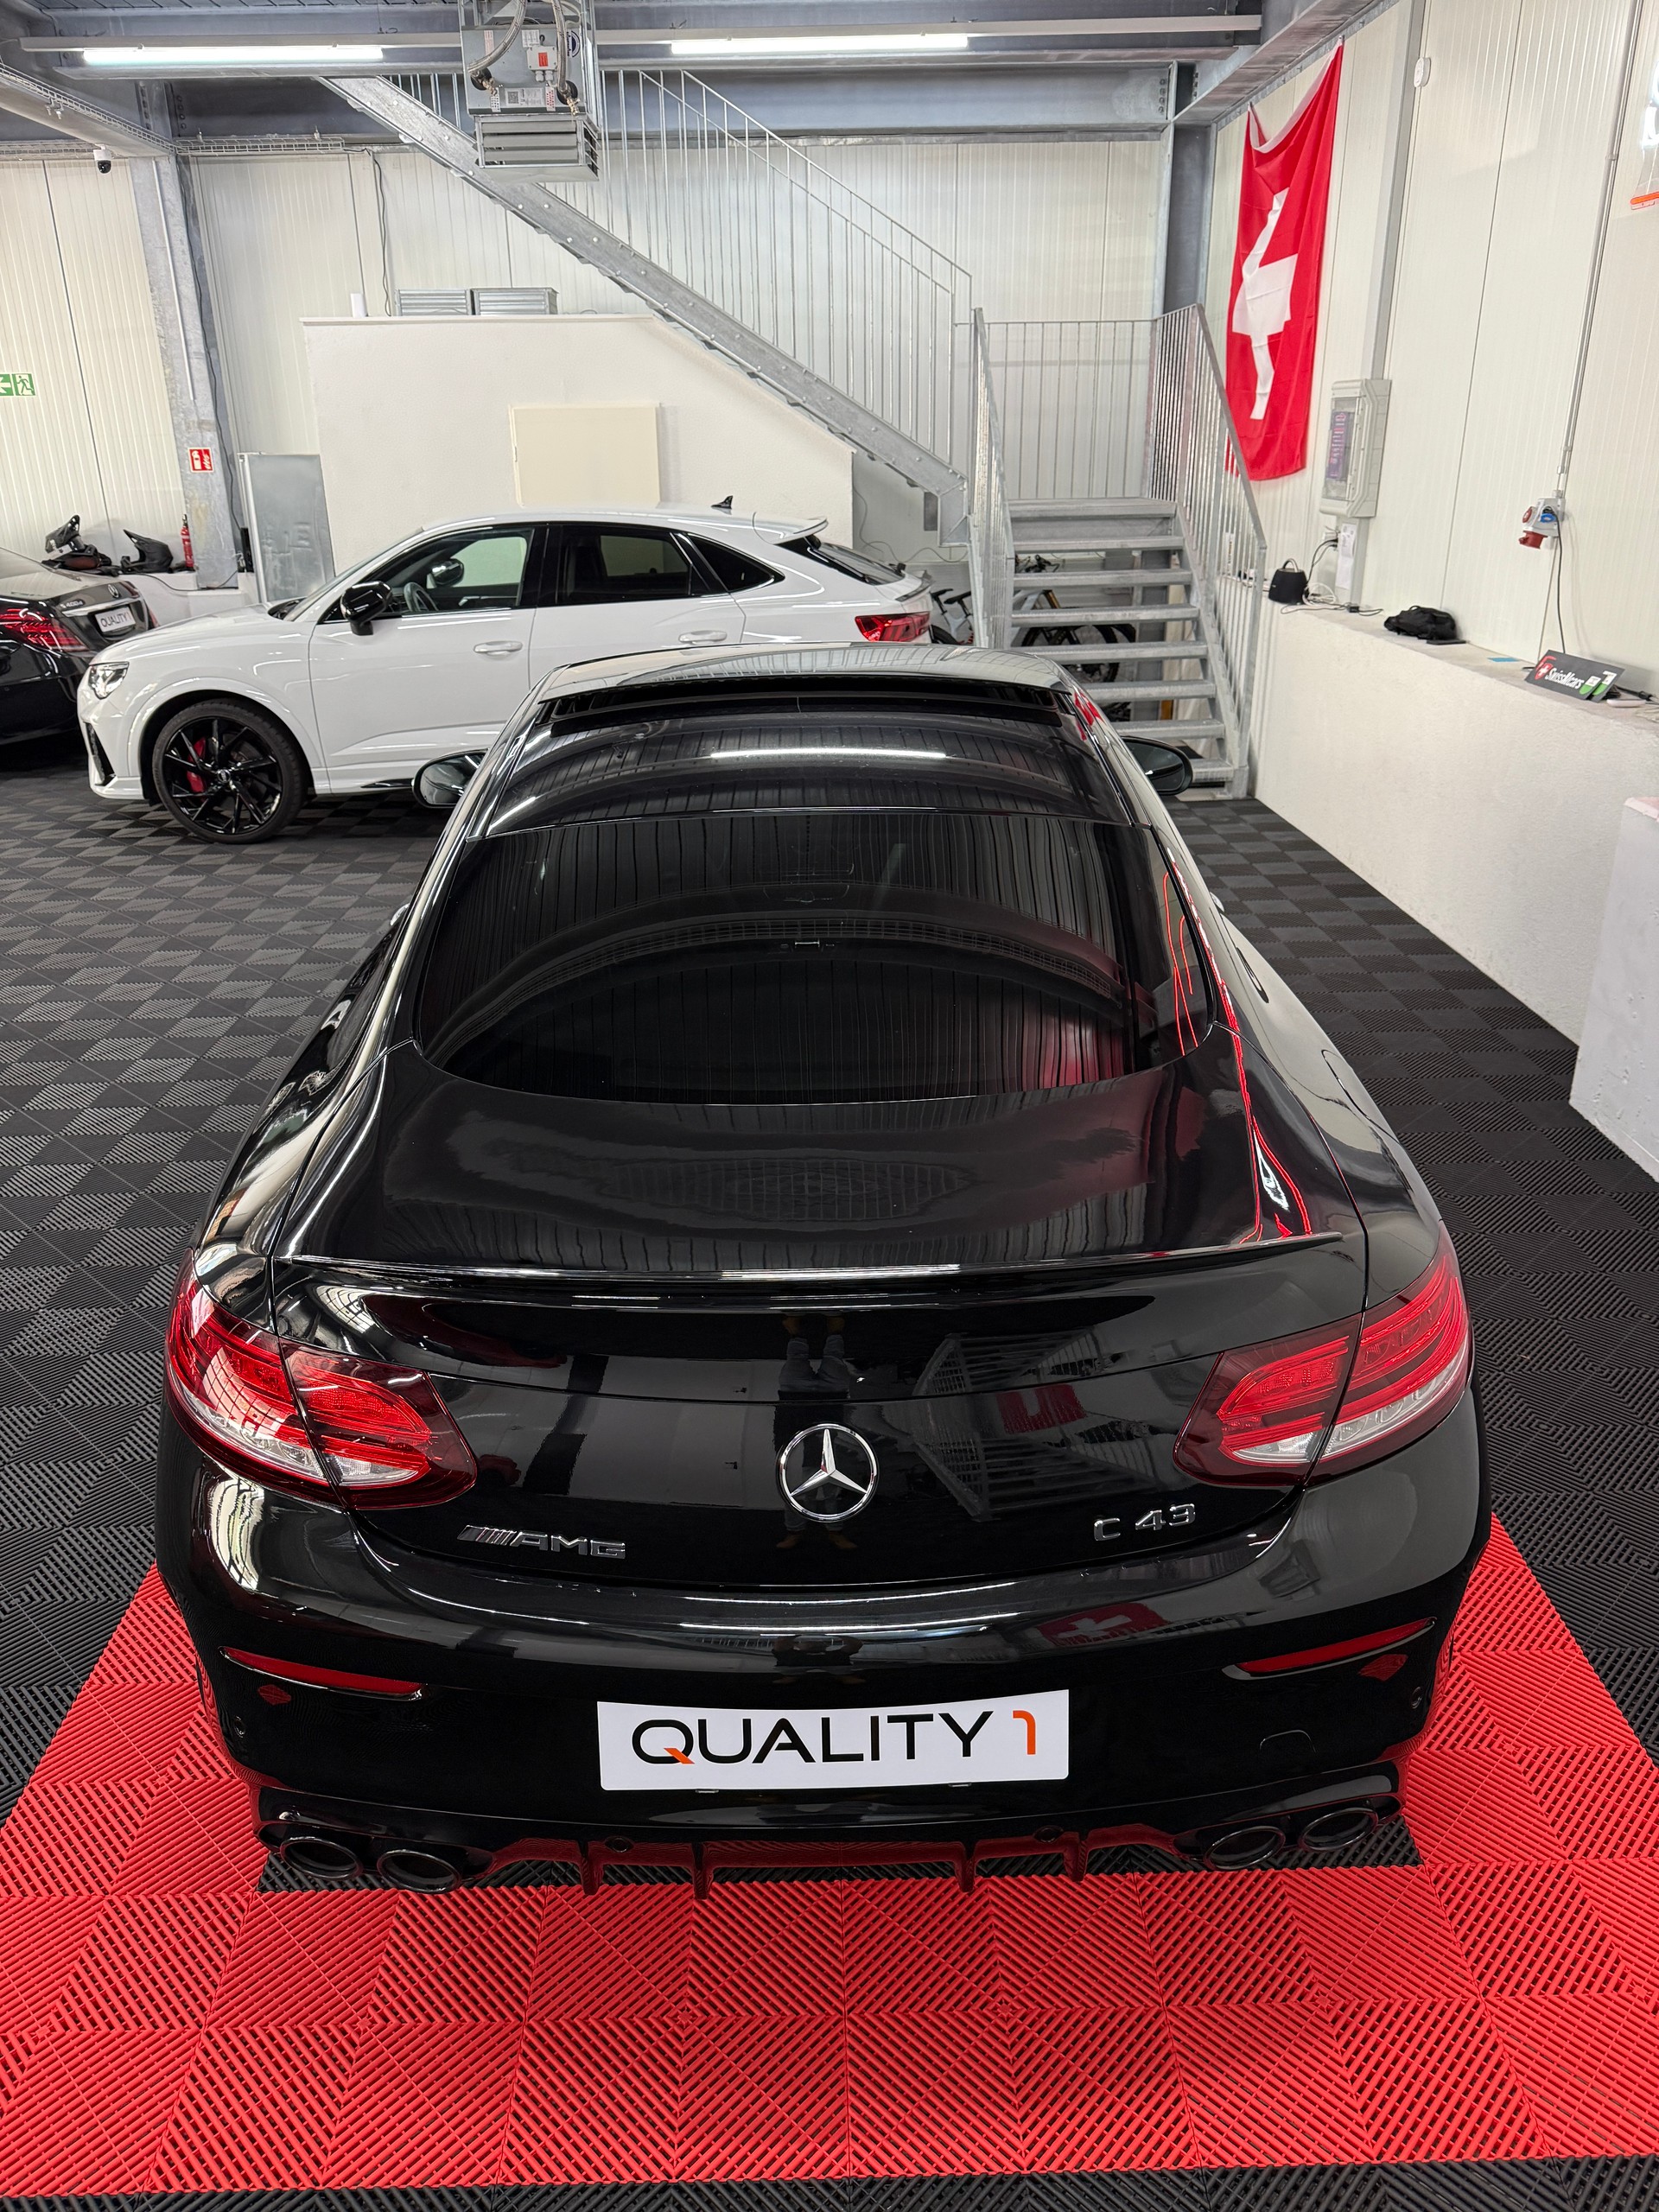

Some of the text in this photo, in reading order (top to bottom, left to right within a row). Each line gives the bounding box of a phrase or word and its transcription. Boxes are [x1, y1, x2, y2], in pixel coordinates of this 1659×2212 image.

[100, 613, 127, 627] QUALITY
[1094, 1503, 1196, 1541] C 43
[510, 1530, 626, 1559] AMG
[632, 1710, 1036, 1764] QUALITY 1
